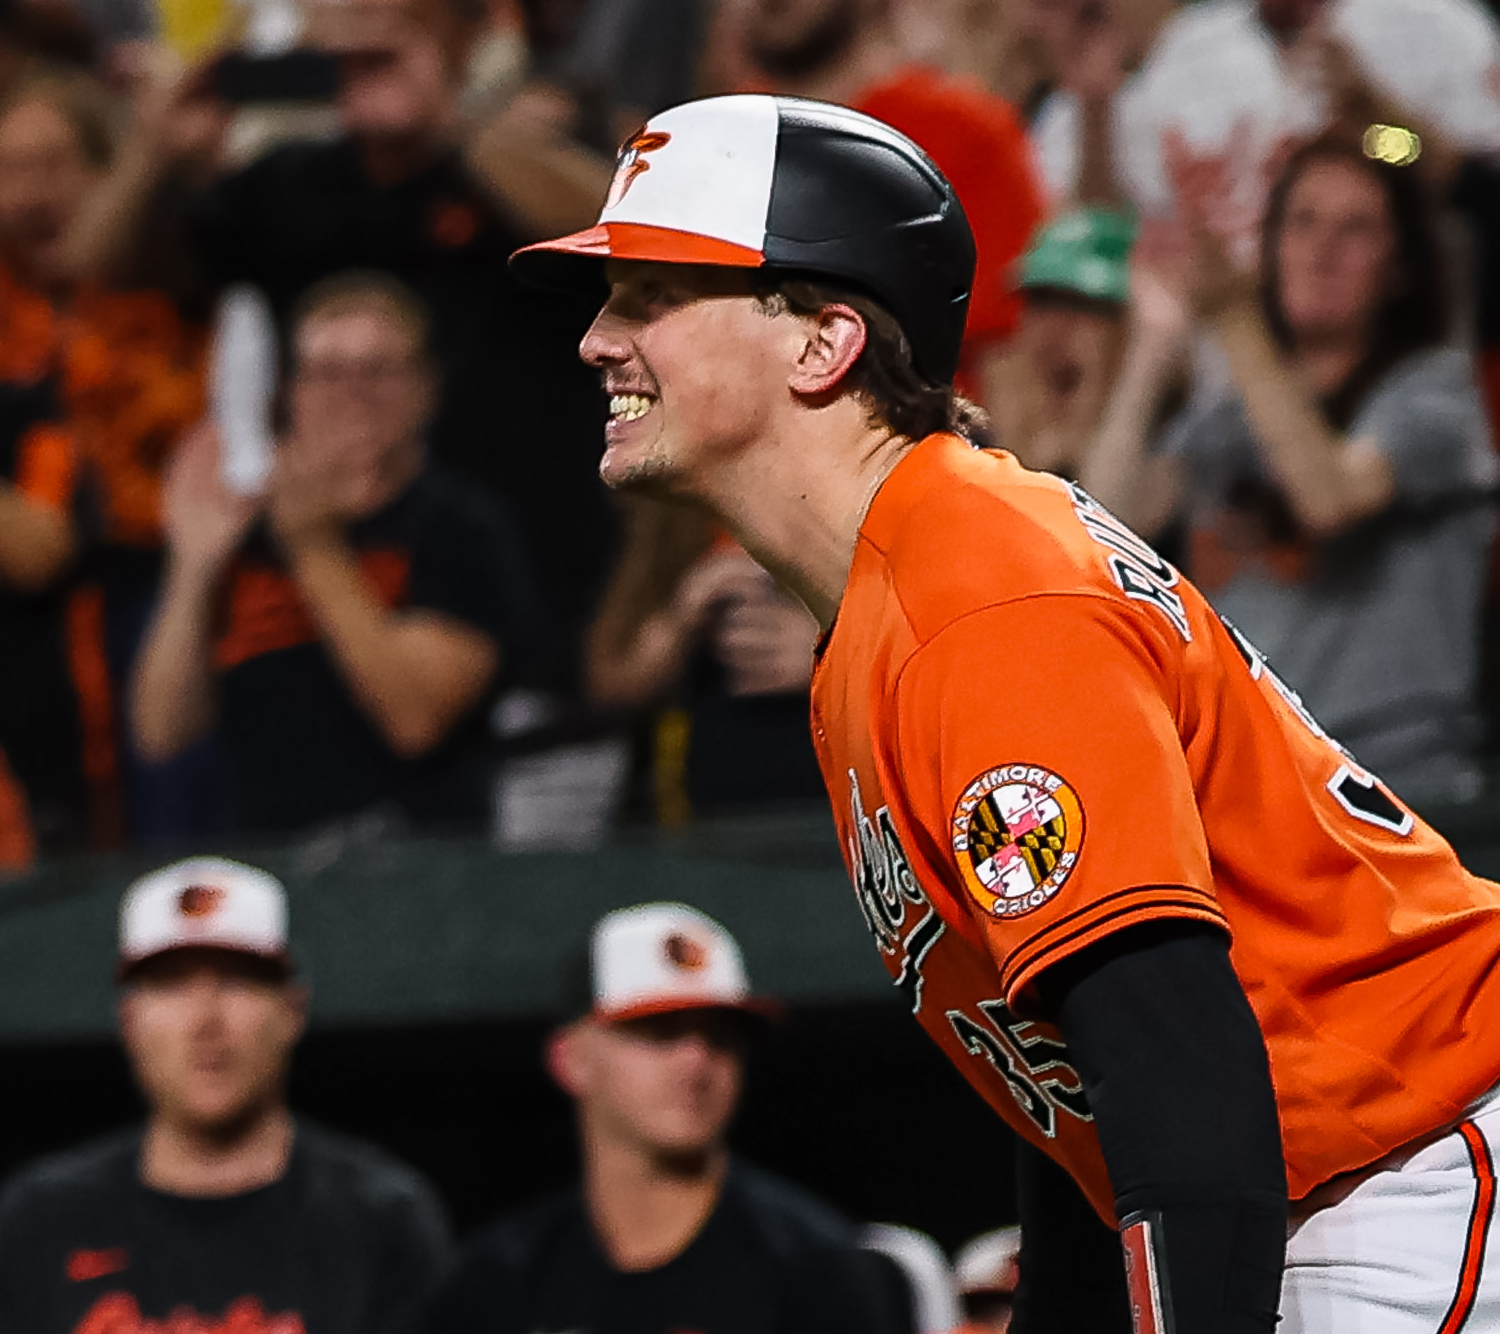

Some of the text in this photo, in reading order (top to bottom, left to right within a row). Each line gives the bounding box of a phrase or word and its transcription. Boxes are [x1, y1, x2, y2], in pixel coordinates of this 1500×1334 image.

[953, 765, 1064, 851] BALTIMORE
[992, 851, 1078, 915] ORIOLES
[946, 998, 1095, 1139] 35
